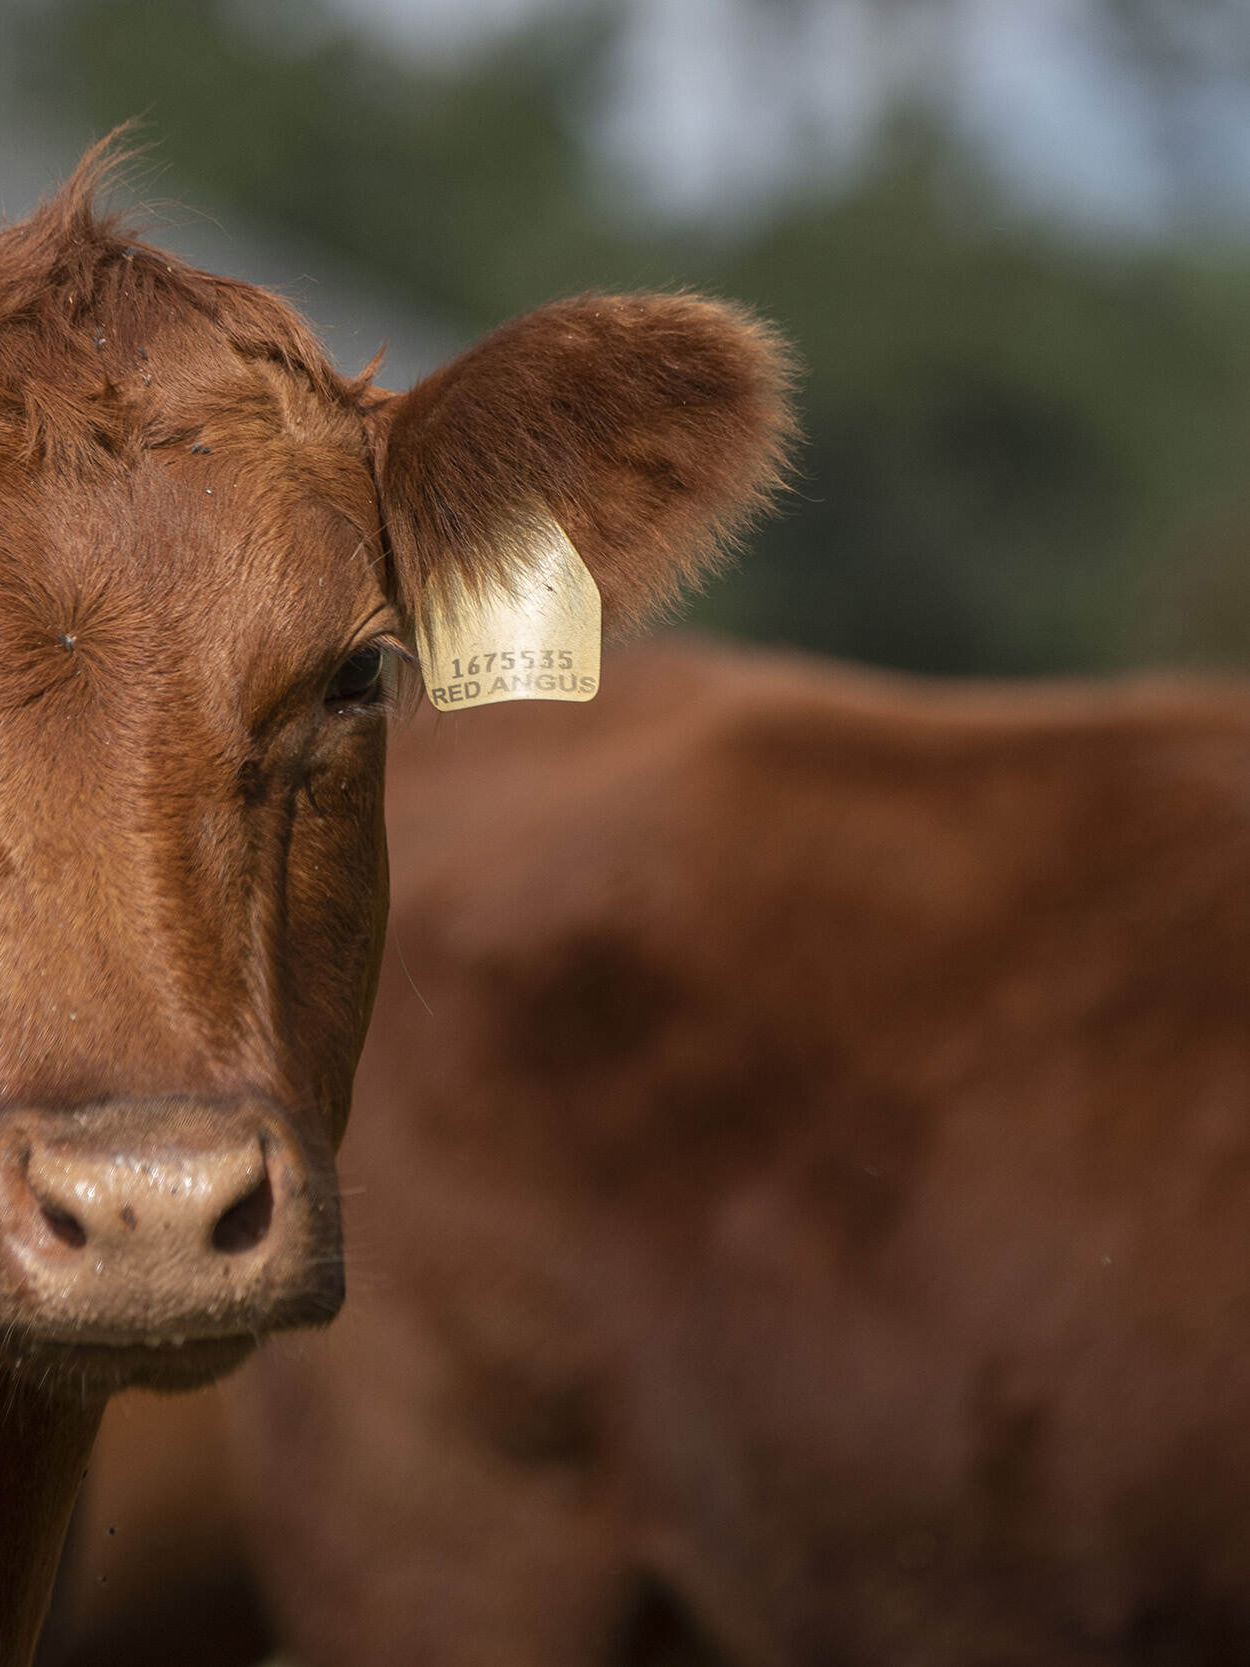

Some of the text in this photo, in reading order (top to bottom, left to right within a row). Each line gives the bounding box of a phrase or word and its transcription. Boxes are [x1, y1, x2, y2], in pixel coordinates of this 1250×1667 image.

[452, 650, 574, 679] 1675535
[431, 674, 596, 706] RED ANGUS
